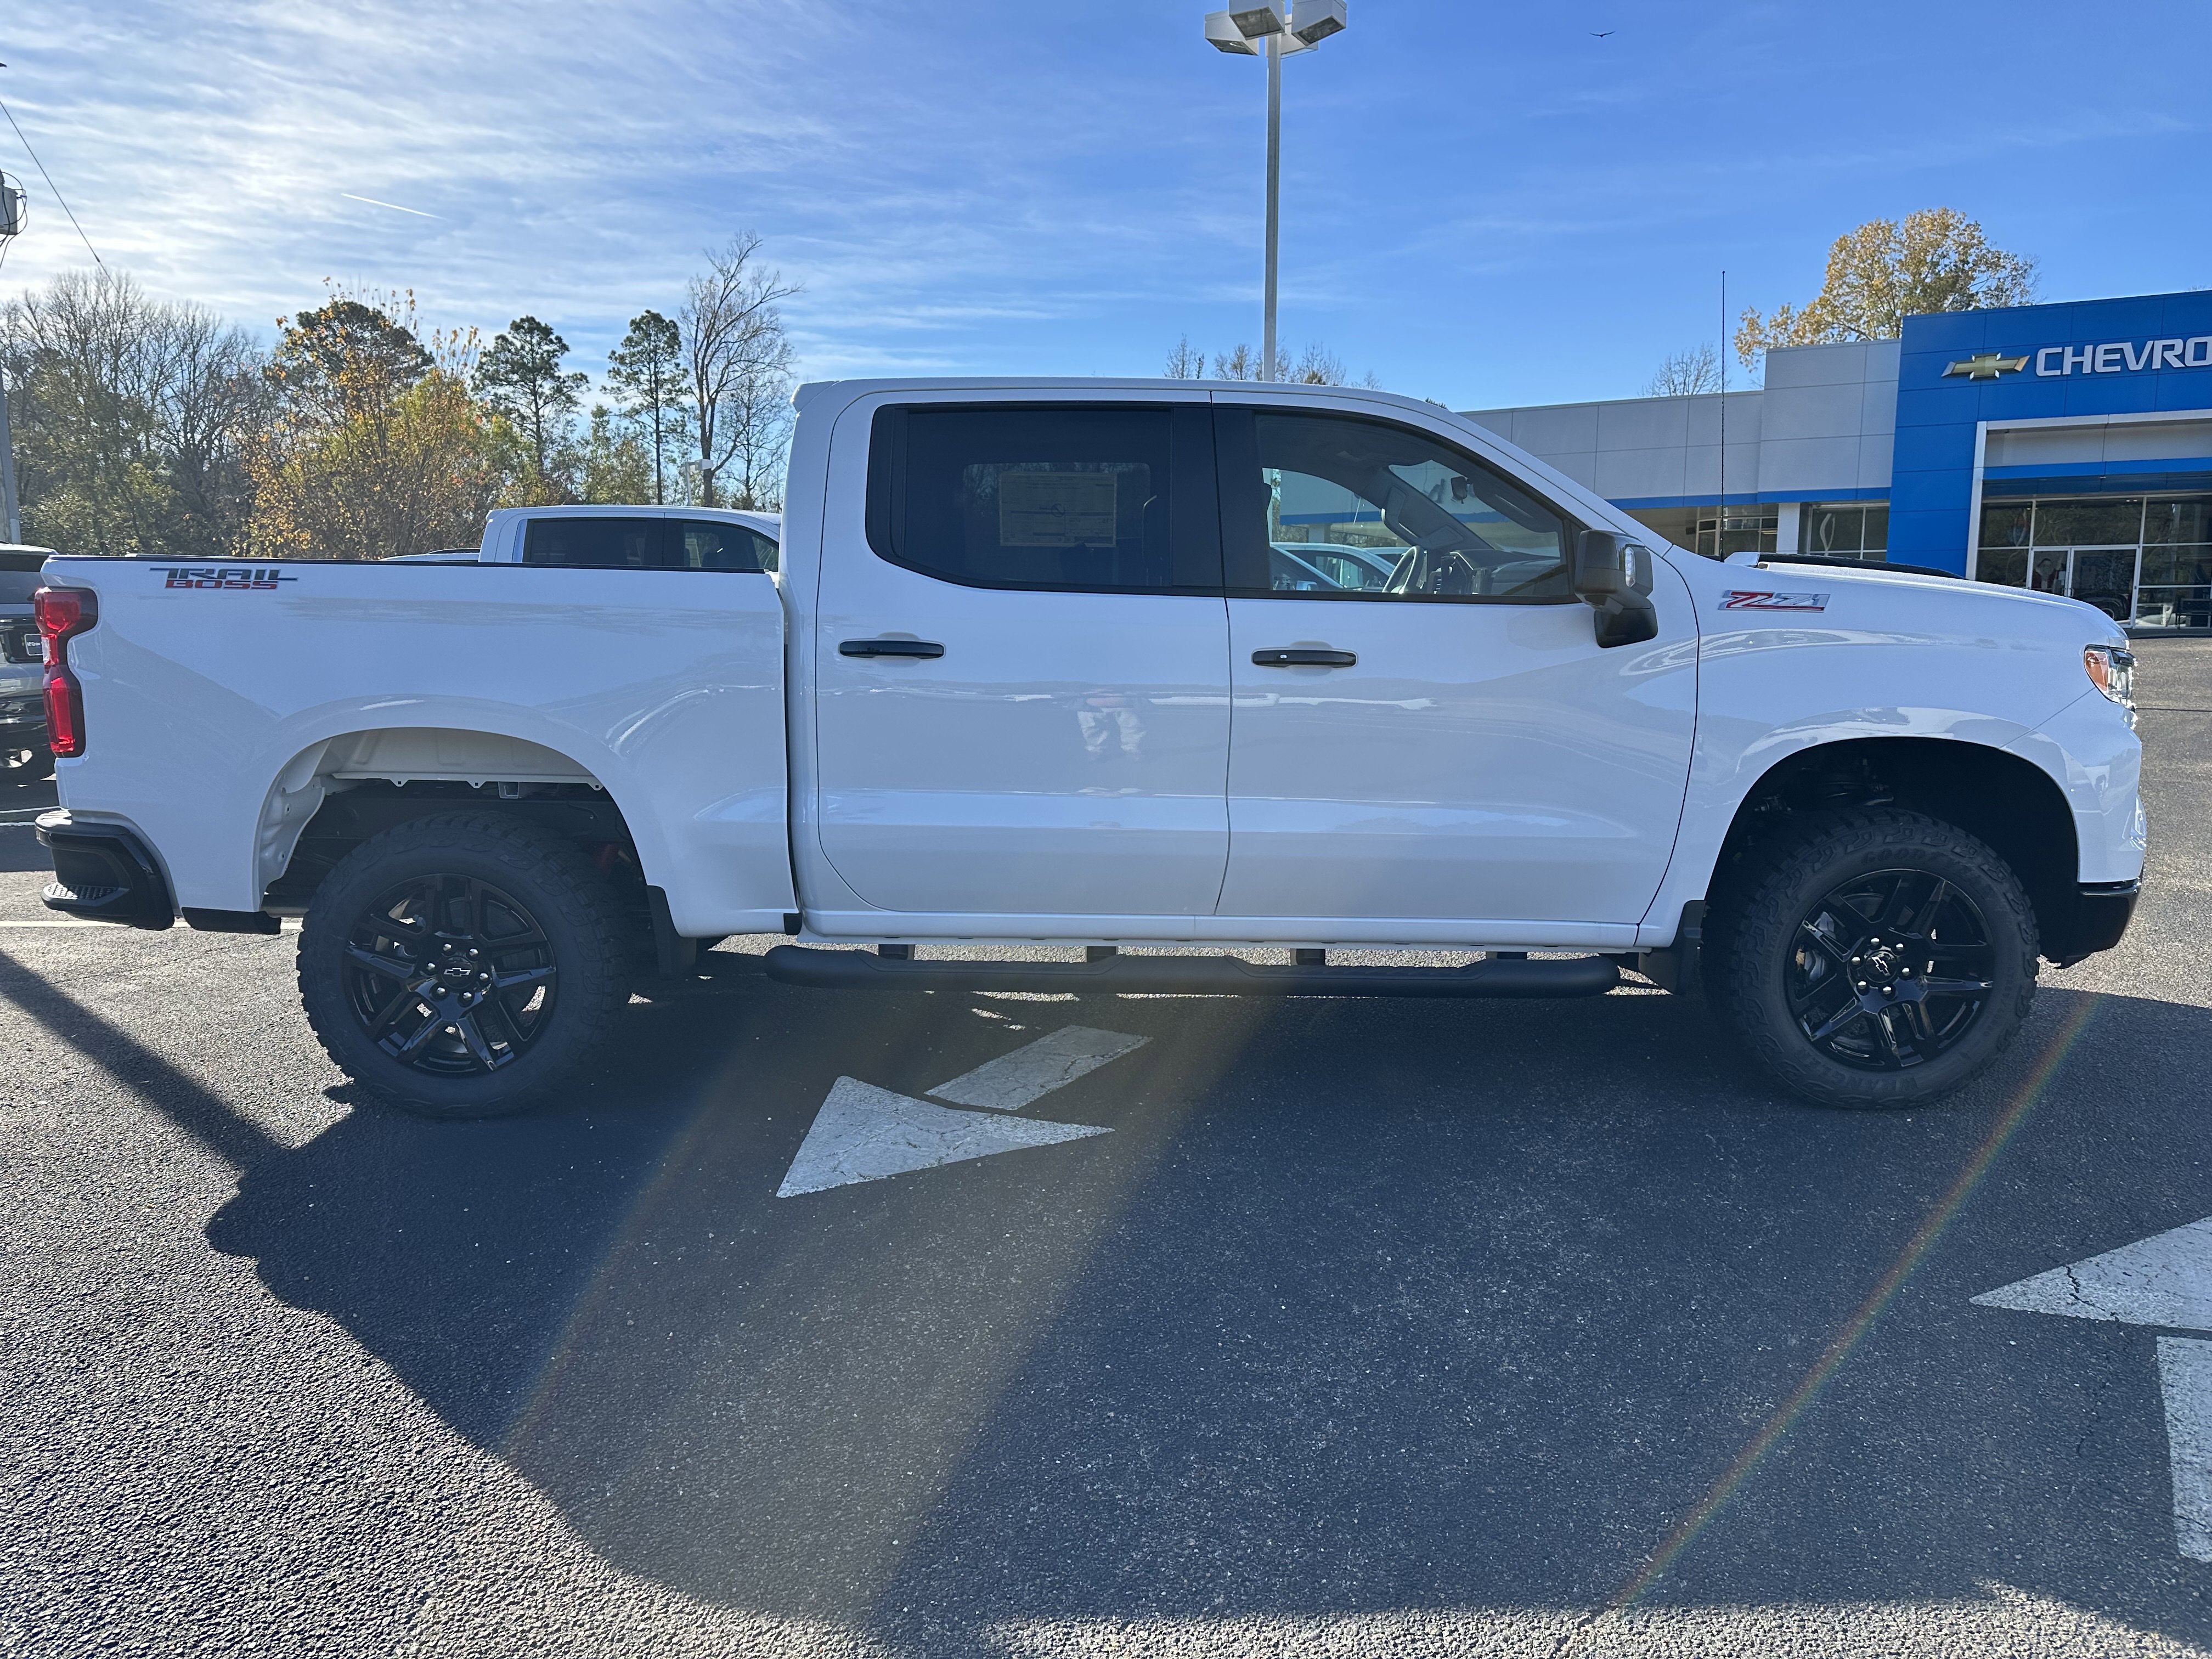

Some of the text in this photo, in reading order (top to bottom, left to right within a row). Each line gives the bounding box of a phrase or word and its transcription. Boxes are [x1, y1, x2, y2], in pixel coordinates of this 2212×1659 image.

[2036, 336, 2212, 377] CHEVRO
[149, 567, 298, 582] TRAIL
[165, 579, 279, 590] BOSS
[1718, 590, 1831, 613] Z71
